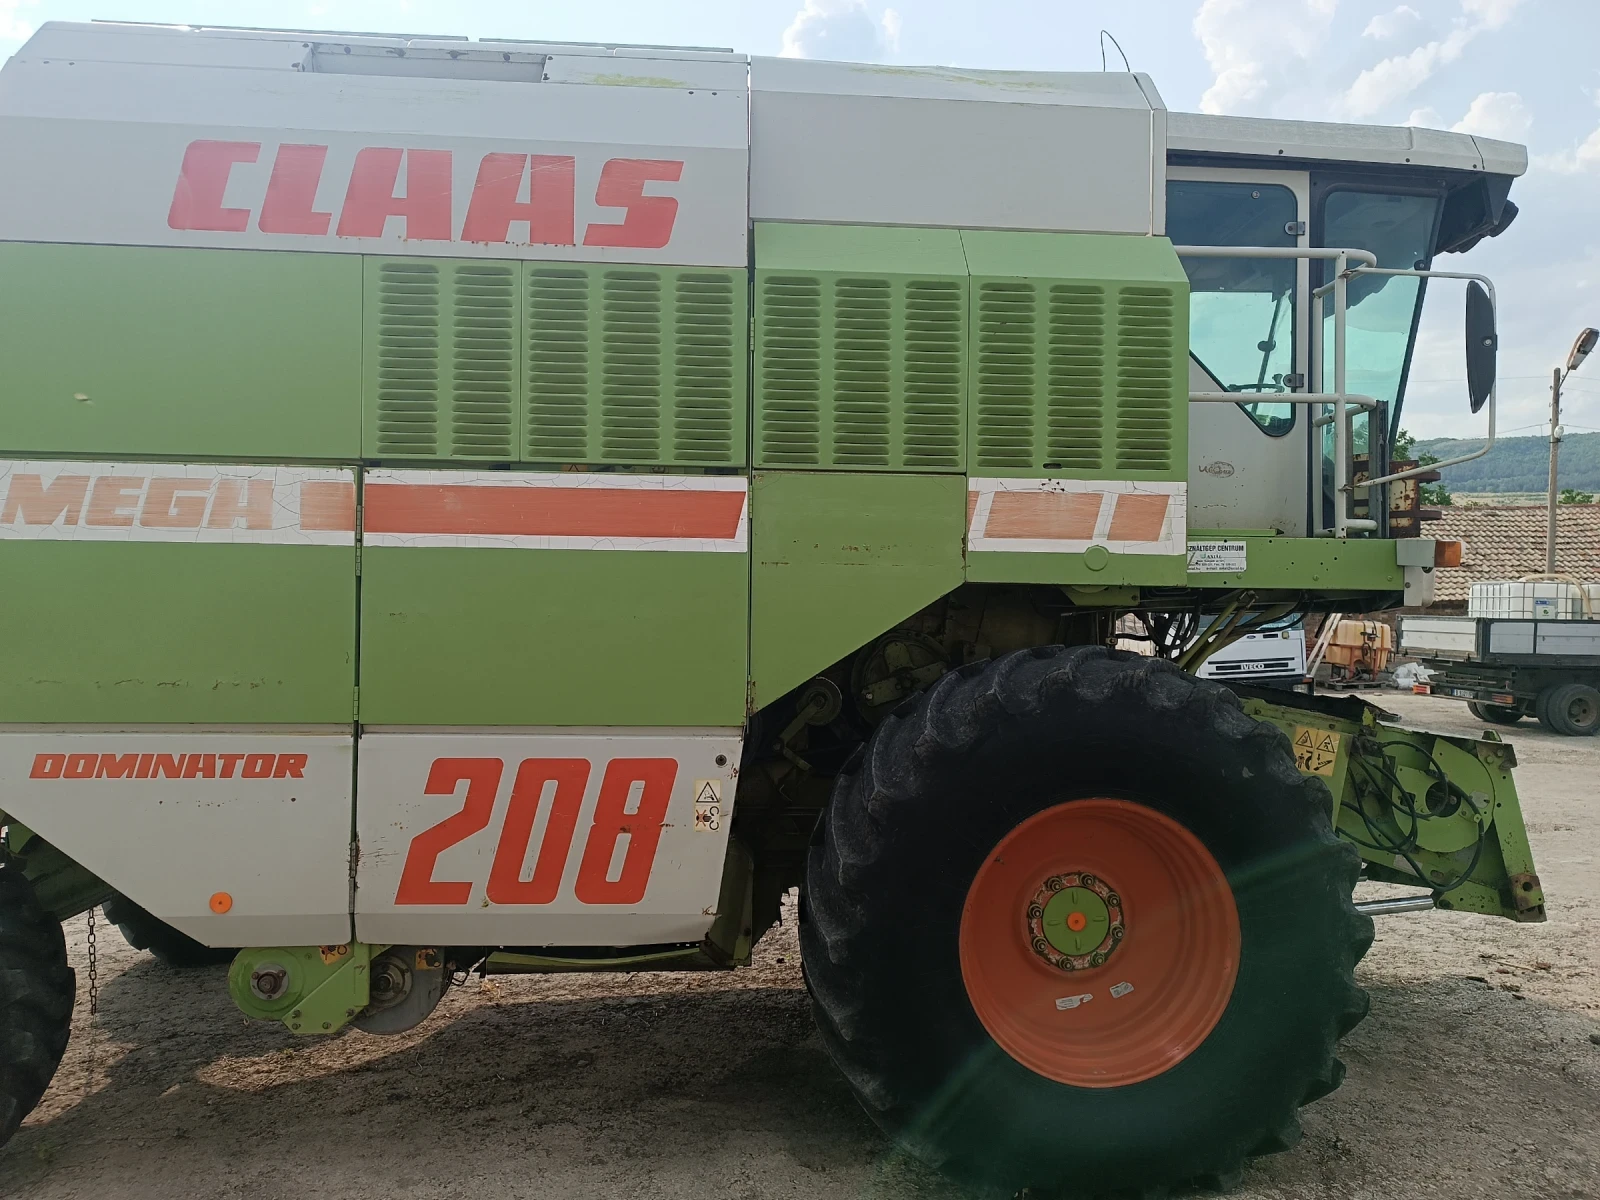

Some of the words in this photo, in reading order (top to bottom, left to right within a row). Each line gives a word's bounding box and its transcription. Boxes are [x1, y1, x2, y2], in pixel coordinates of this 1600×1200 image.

[167, 139, 684, 249] CLAAS
[0, 473, 275, 530] MEGA
[30, 753, 308, 779] DOMINATOR
[395, 756, 679, 905] 208
